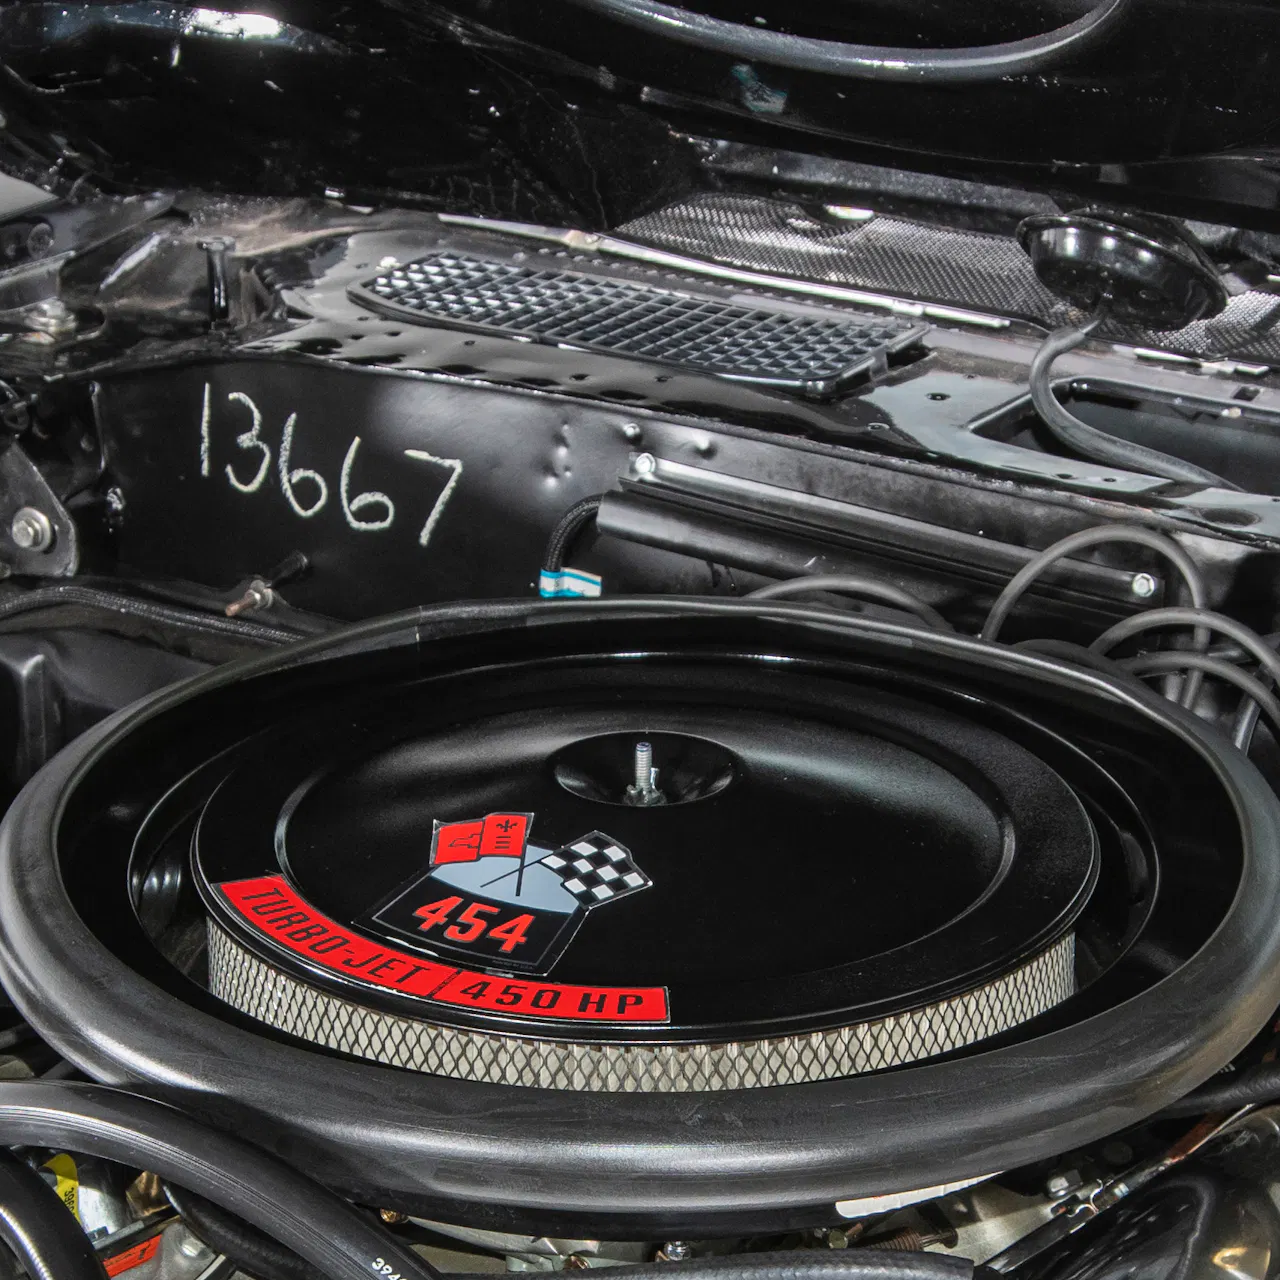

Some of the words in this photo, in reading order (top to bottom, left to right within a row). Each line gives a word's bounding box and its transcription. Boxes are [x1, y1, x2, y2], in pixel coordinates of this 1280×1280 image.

[200, 382, 463, 546] 13667
[241, 888, 431, 984] TURBO-JET
[459, 980, 559, 1009] 450
[577, 992, 645, 1014] HP
[413, 894, 537, 954] 454
